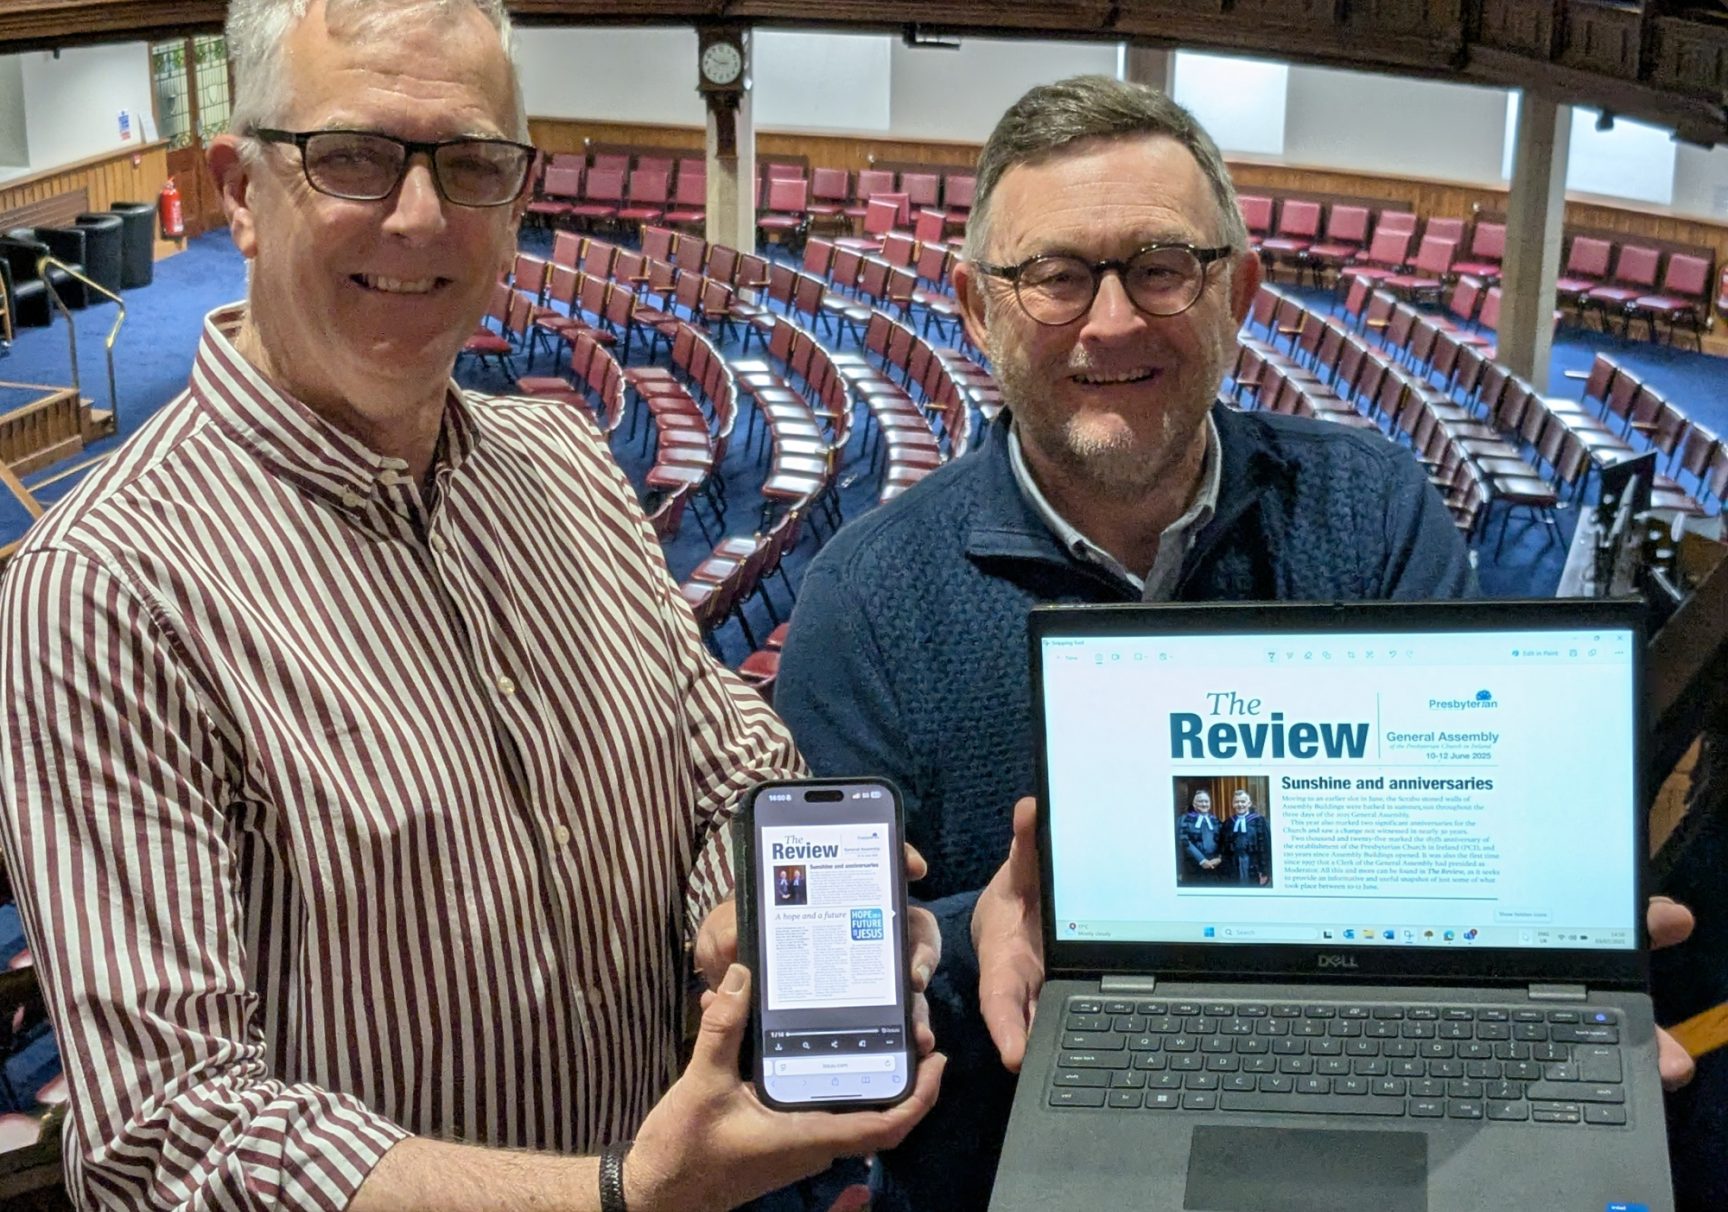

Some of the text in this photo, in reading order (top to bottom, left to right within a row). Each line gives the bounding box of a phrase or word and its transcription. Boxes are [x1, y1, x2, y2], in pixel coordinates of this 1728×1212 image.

[1206, 691, 1261, 716] The
[1428, 699, 1498, 710] Presbyterian
[1170, 712, 1370, 760] Review
[1386, 731, 1499, 744] General Assembly
[1282, 776, 1494, 790] Sunshine and anniversaries
[784, 834, 804, 844] The
[772, 842, 839, 860] Review
[783, 912, 800, 921] hope
[823, 911, 846, 920] future
[851, 910, 872, 919] HOPE
[852, 920, 882, 928] FUTURE
[856, 928, 882, 939] JESUS
[1318, 954, 1358, 968] DELL
